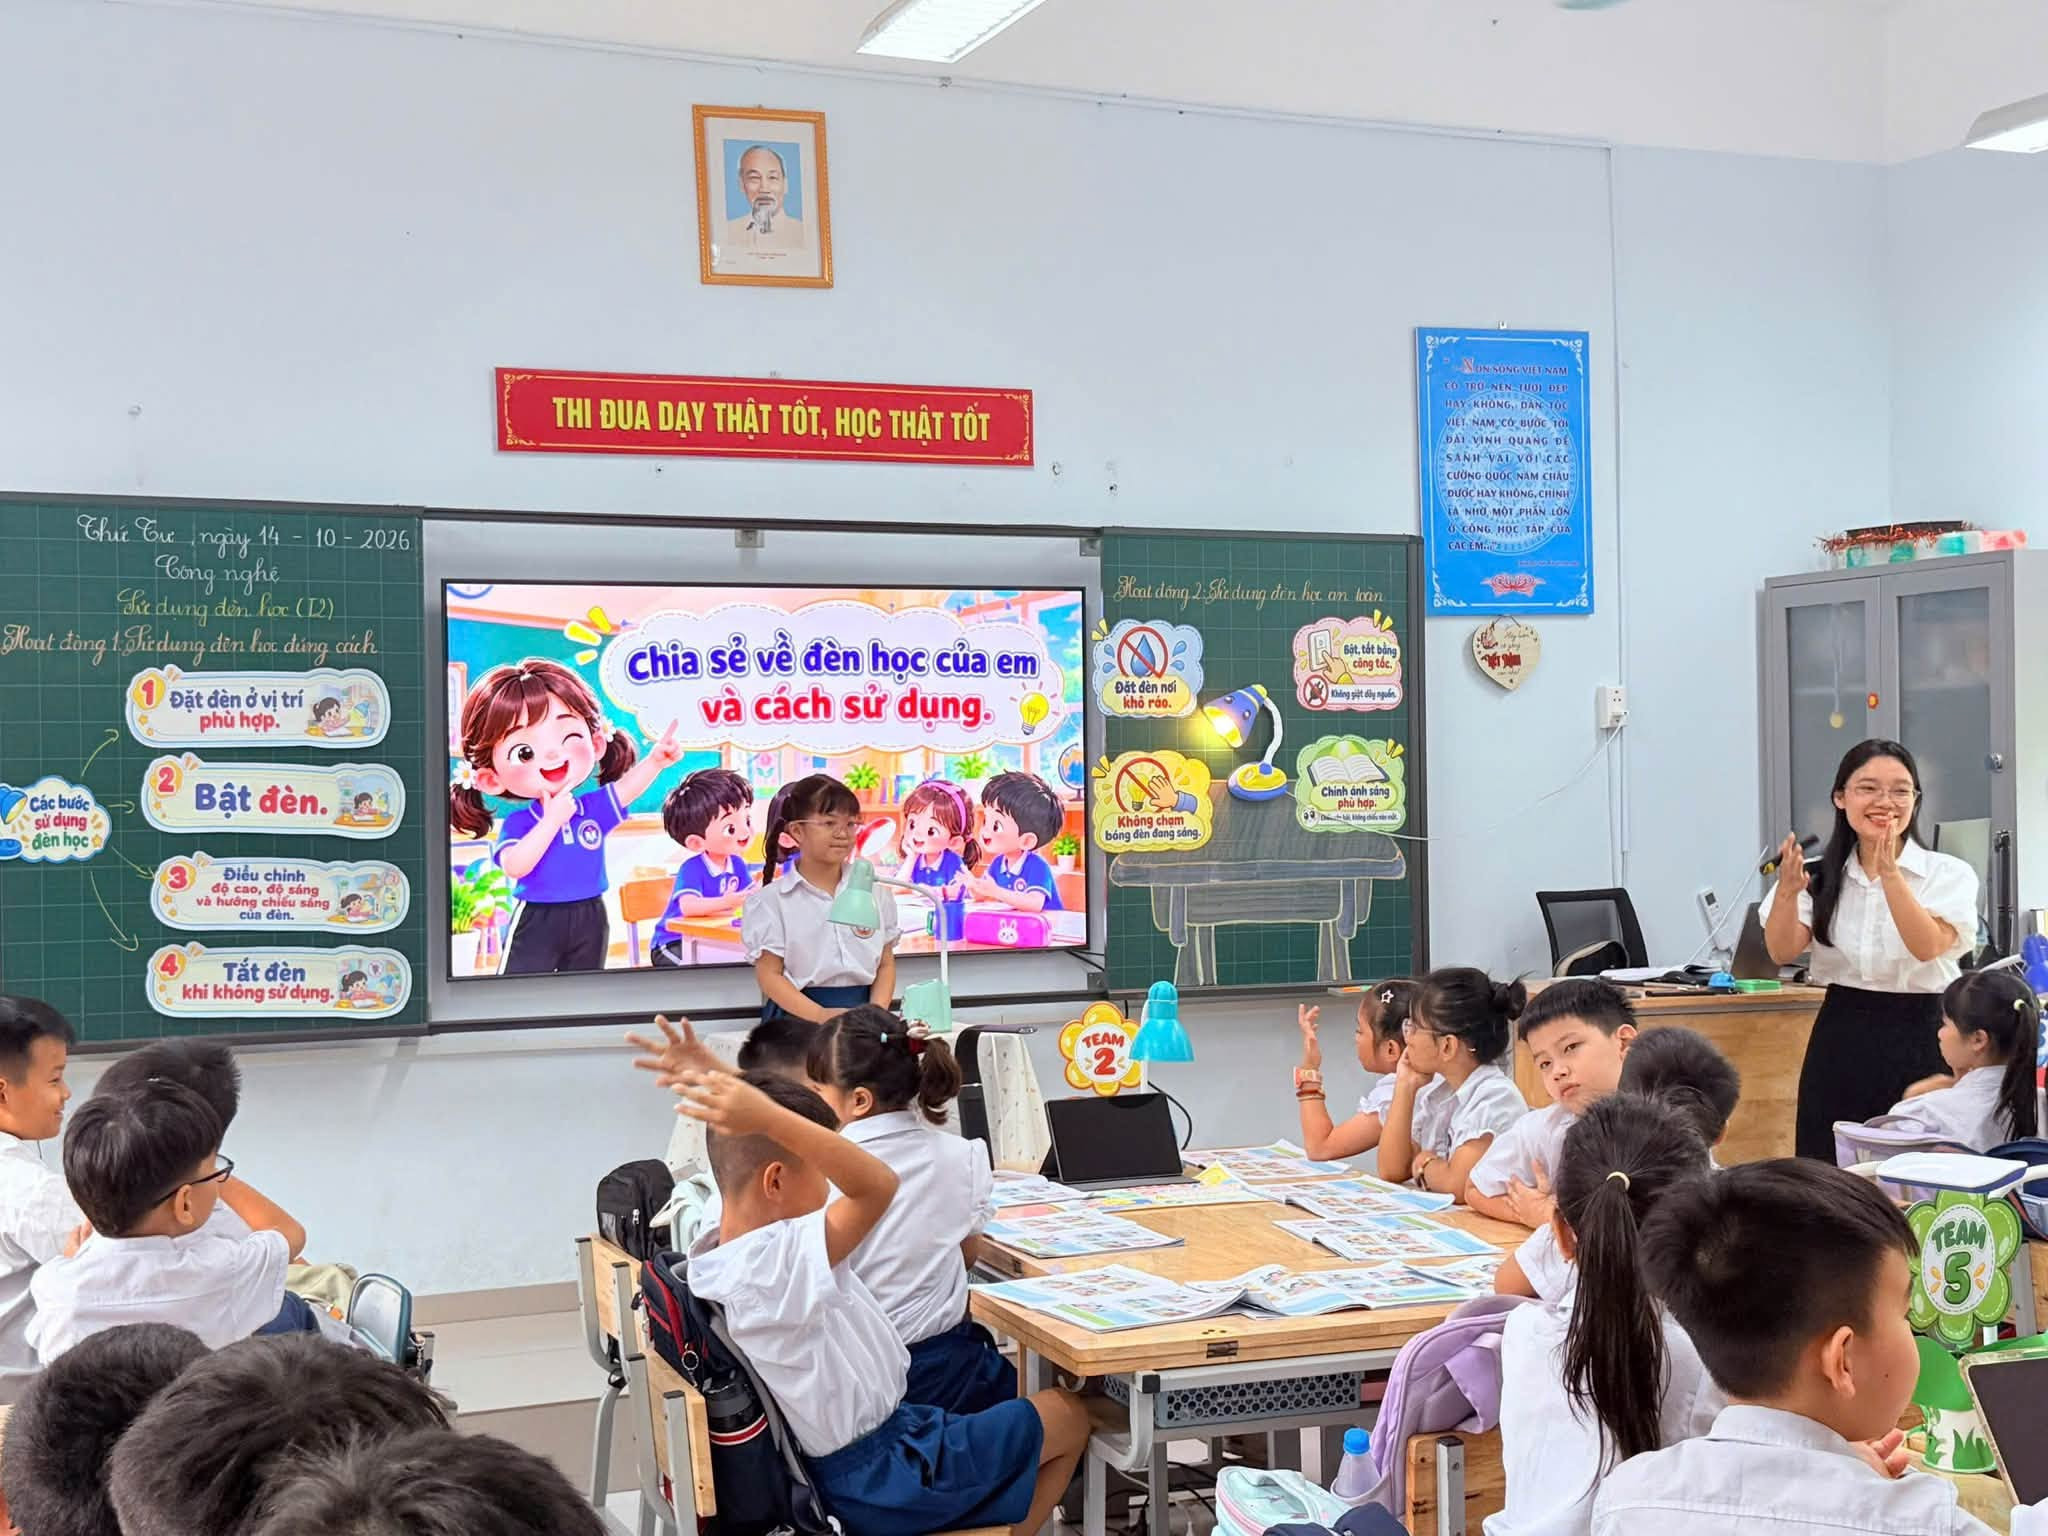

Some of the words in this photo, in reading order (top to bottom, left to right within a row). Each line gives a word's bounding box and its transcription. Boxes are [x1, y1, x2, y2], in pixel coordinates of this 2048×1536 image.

[553, 397, 591, 430] THI
[600, 398, 651, 432] ĐUA
[659, 400, 704, 438] DẠY
[713, 397, 771, 441] THẬT
[779, 395, 828, 438] TỐT,
[834, 407, 882, 444] HỌC
[889, 404, 944, 446] THẬT
[951, 401, 990, 442] TỐT
[77, 513, 129, 543] Thứ
[199, 527, 252, 559] ngày
[259, 525, 280, 546] 14
[316, 527, 337, 548] 10
[360, 528, 411, 551] 2026
[335, 629, 378, 654] cách
[628, 644, 699, 682] Chia
[710, 634, 746, 675] sẻ
[757, 631, 794, 674] về
[804, 642, 861, 673] đèn
[872, 643, 927, 682] học
[936, 641, 988, 675] của
[997, 654, 1038, 676] em
[142, 680, 154, 705] 1
[1115, 681, 1136, 696] Đặt
[1139, 680, 1158, 693] đèn
[1161, 680, 1176, 693] nơi
[170, 690, 205, 712] Đặt
[208, 689, 241, 708] đèn
[246, 687, 257, 708] ở
[262, 690, 277, 712] vị
[282, 689, 304, 708] trí
[701, 686, 742, 723] và
[754, 686, 831, 720] cách
[844, 684, 888, 719] sử
[899, 688, 992, 731] dụng.
[1123, 695, 1144, 709] khô
[1149, 695, 1172, 708] ráo.
[200, 711, 235, 733] phù
[240, 711, 280, 732] hợp.
[157, 766, 175, 793] 2
[30, 794, 55, 812] Các
[58, 794, 89, 811] bước
[195, 782, 252, 819] Bật
[259, 784, 328, 815] đèn.
[1338, 797, 1355, 809] phù
[1358, 798, 1376, 810] hợp.
[35, 812, 51, 830] sử
[53, 812, 87, 831] dụng
[1118, 815, 1153, 828] Không
[1156, 814, 1184, 828] chạm
[32, 832, 60, 850] đèn
[63, 832, 89, 851] học
[1105, 830, 1131, 842] bóng
[1133, 828, 1150, 839] đèn
[1152, 828, 1175, 840] đang
[1177, 827, 1201, 839] sáng.
[168, 866, 188, 889] 3
[224, 865, 259, 882] Điều
[264, 868, 306, 882] chỉnh
[211, 883, 229, 896] độ
[234, 885, 262, 895] cao,
[267, 883, 284, 896] độ
[288, 884, 320, 898] sáng
[196, 896, 211, 906] và
[217, 896, 257, 909] hướng
[262, 895, 296, 907] chiếu
[300, 897, 330, 910] sáng
[239, 909, 262, 920] của
[267, 910, 294, 921] đèn.
[160, 954, 178, 976] 4
[223, 957, 259, 982] Tắt
[265, 961, 306, 982] đèn
[182, 984, 208, 1000] khi
[213, 984, 265, 1003] không
[268, 984, 289, 1000] sử
[290, 985, 335, 1003] dụng.
[1082, 1032, 1125, 1048] TEAM
[1094, 1048, 1116, 1075] 2
[1932, 1219, 1987, 1252] TEAM
[1944, 1251, 1971, 1305] 5
